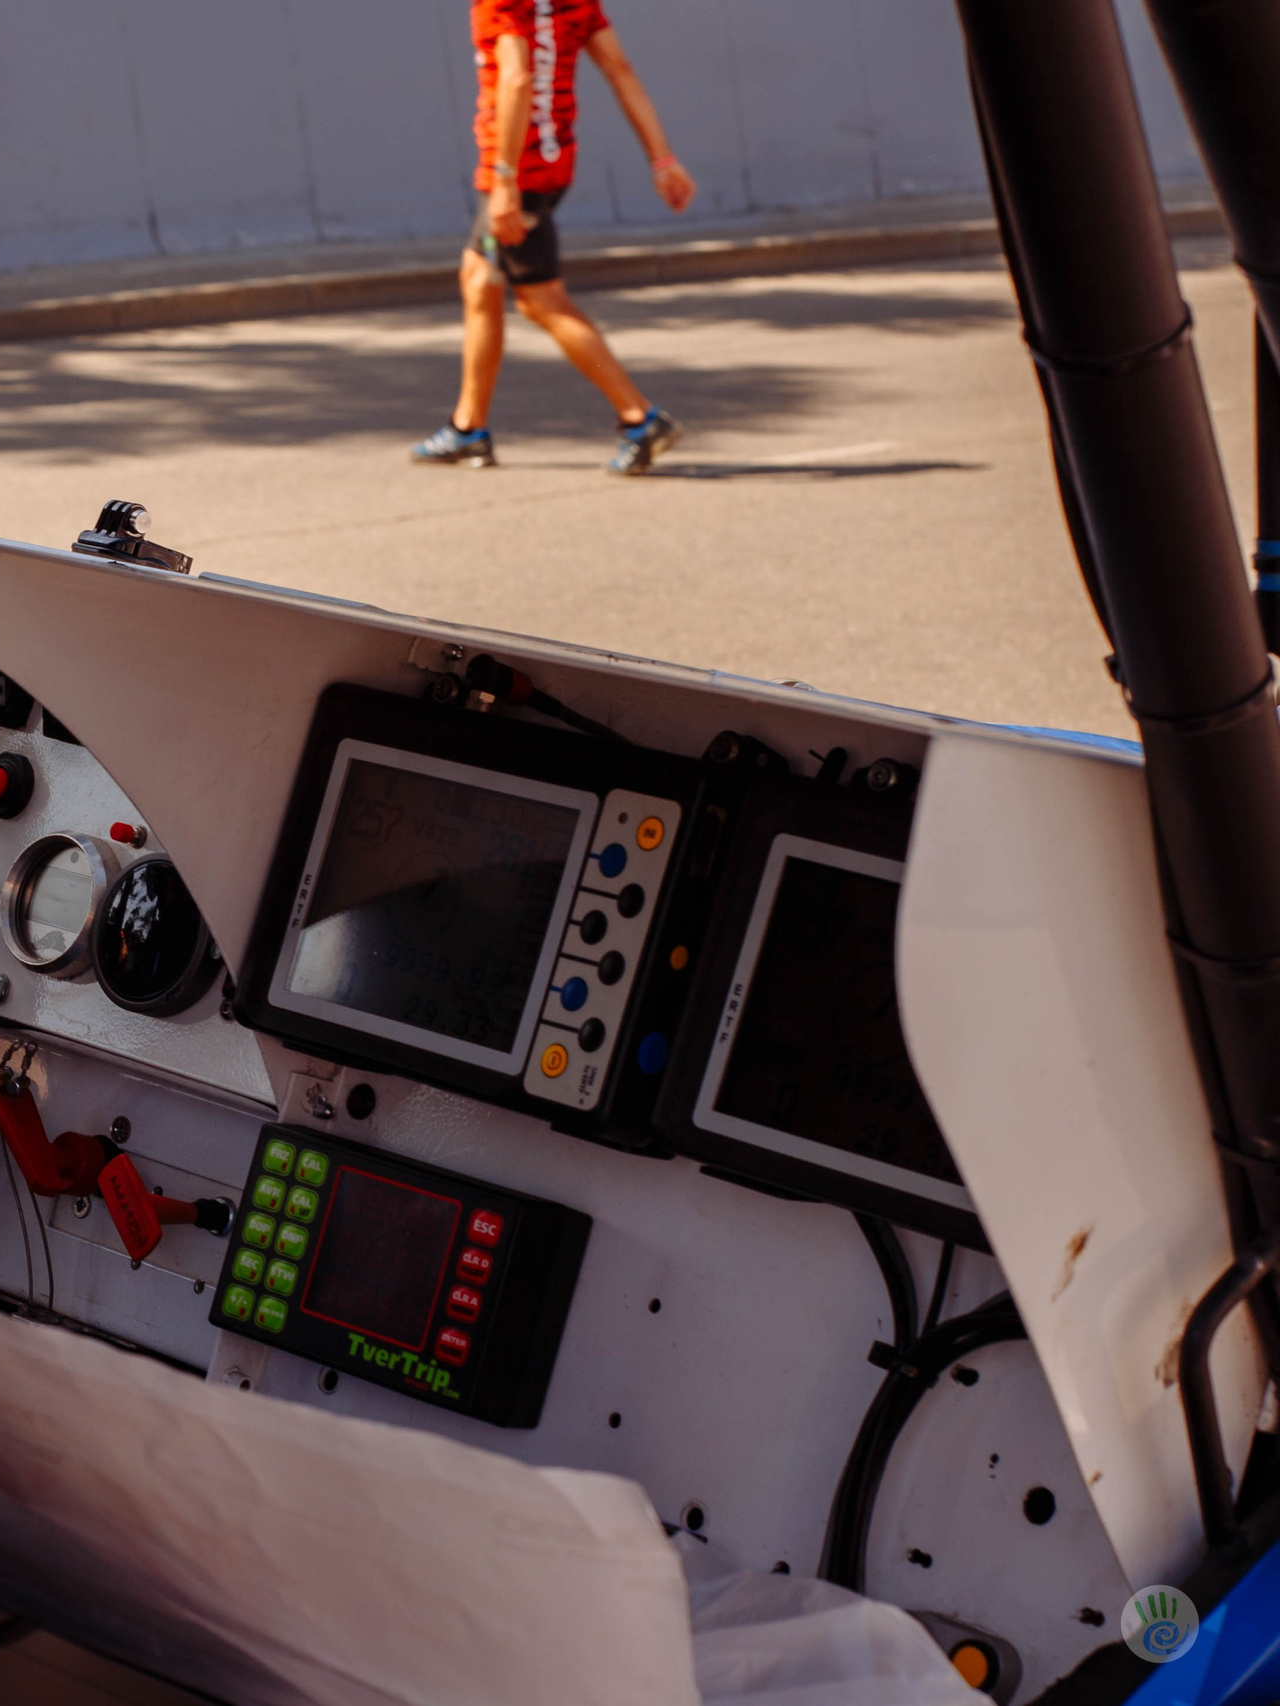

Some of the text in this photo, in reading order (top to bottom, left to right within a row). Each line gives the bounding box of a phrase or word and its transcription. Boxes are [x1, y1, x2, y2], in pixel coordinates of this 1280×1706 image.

[302, 1157, 323, 1172] CAL
[259, 1183, 282, 1198] AVR
[292, 1193, 313, 1208] CAL
[472, 1218, 498, 1237] ESC
[240, 1255, 260, 1270] SEC
[270, 1266, 295, 1282] STW
[470, 1297, 479, 1307] A
[348, 1331, 451, 1393] TverTrip
